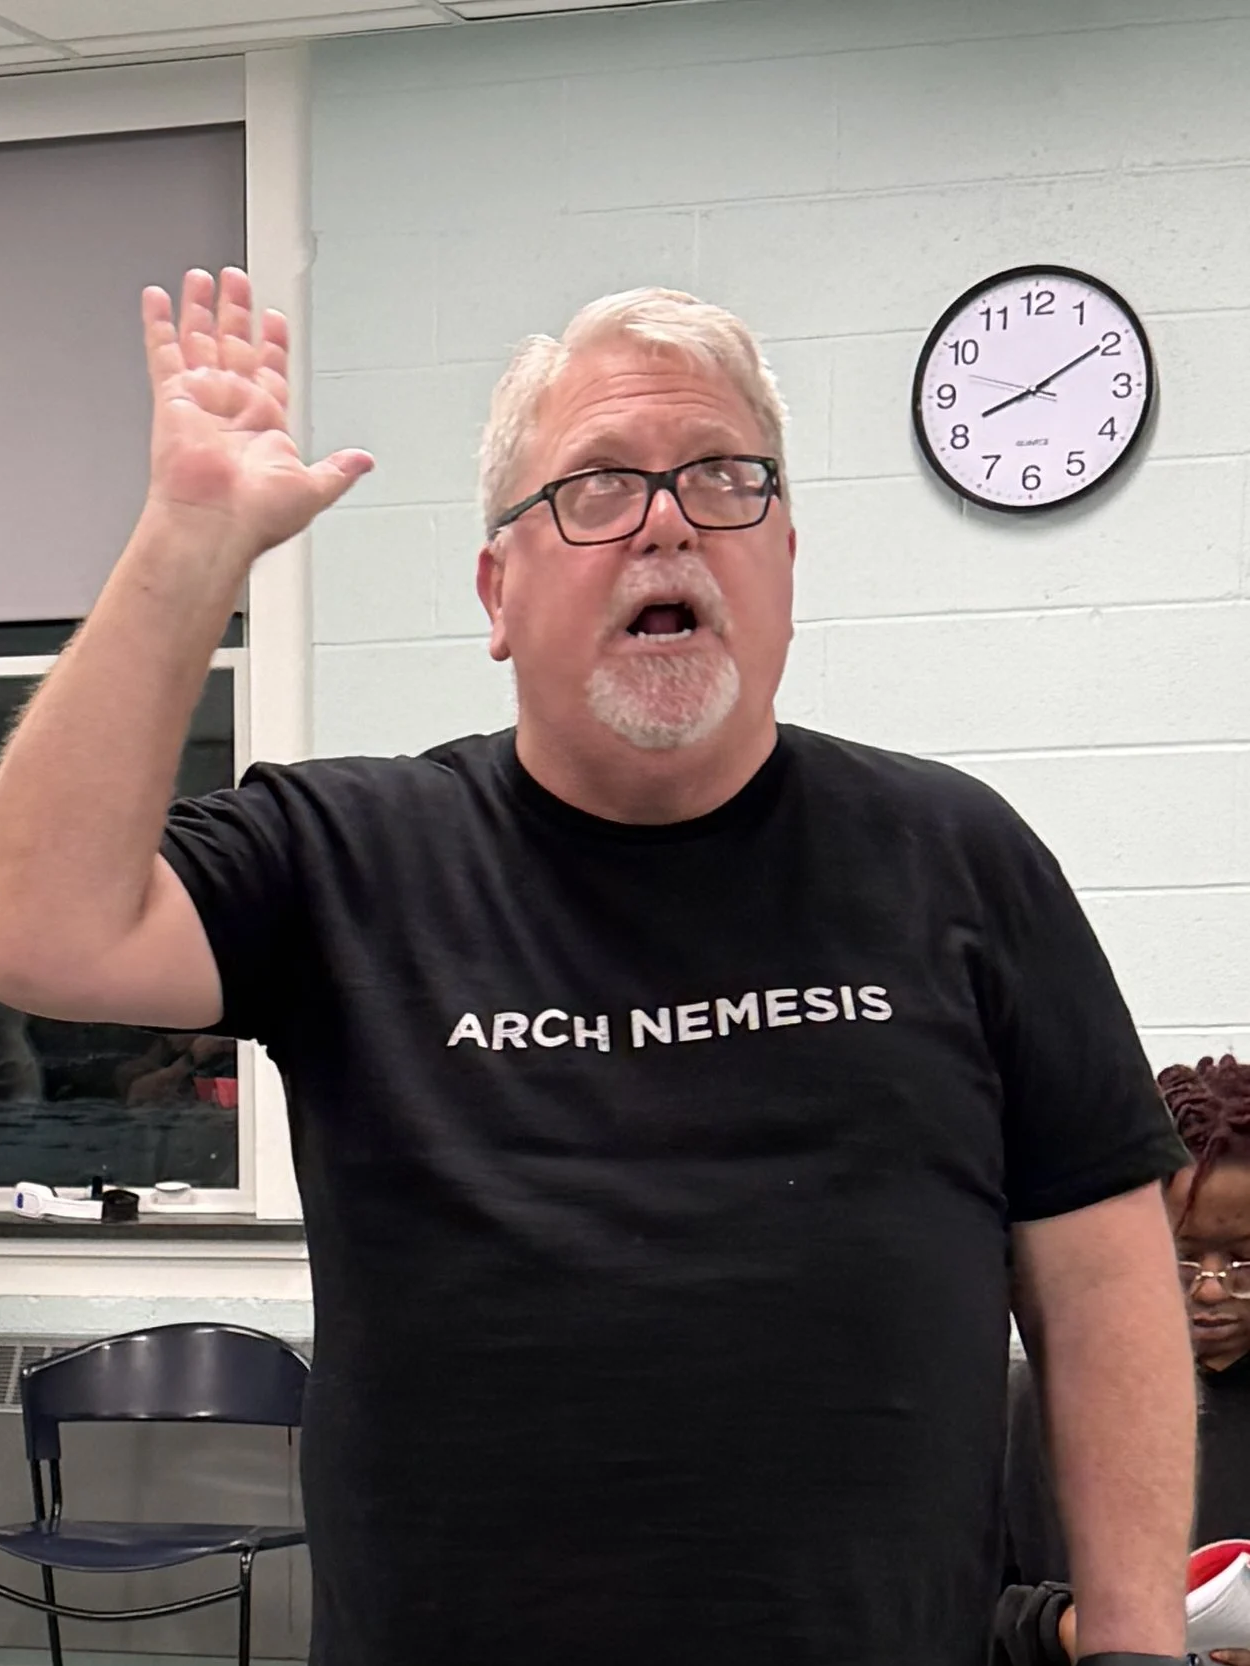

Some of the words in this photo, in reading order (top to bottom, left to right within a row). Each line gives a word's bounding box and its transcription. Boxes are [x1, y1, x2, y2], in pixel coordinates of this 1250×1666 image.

[1020, 291, 1055, 316] 12
[1073, 301, 1085, 326] 1
[979, 306, 1009, 331] 11
[948, 339, 979, 366] 10
[1100, 331, 1122, 356] 2
[936, 383, 957, 410] 9
[1112, 372, 1133, 399] 3
[950, 424, 970, 450] 8
[1098, 416, 1118, 442] 4
[982, 454, 1002, 480] 7
[1066, 451, 1086, 476] 5
[1021, 465, 1042, 491] 6
[446, 1008, 610, 1052] ARCH
[630, 985, 893, 1048] NEMESIS
